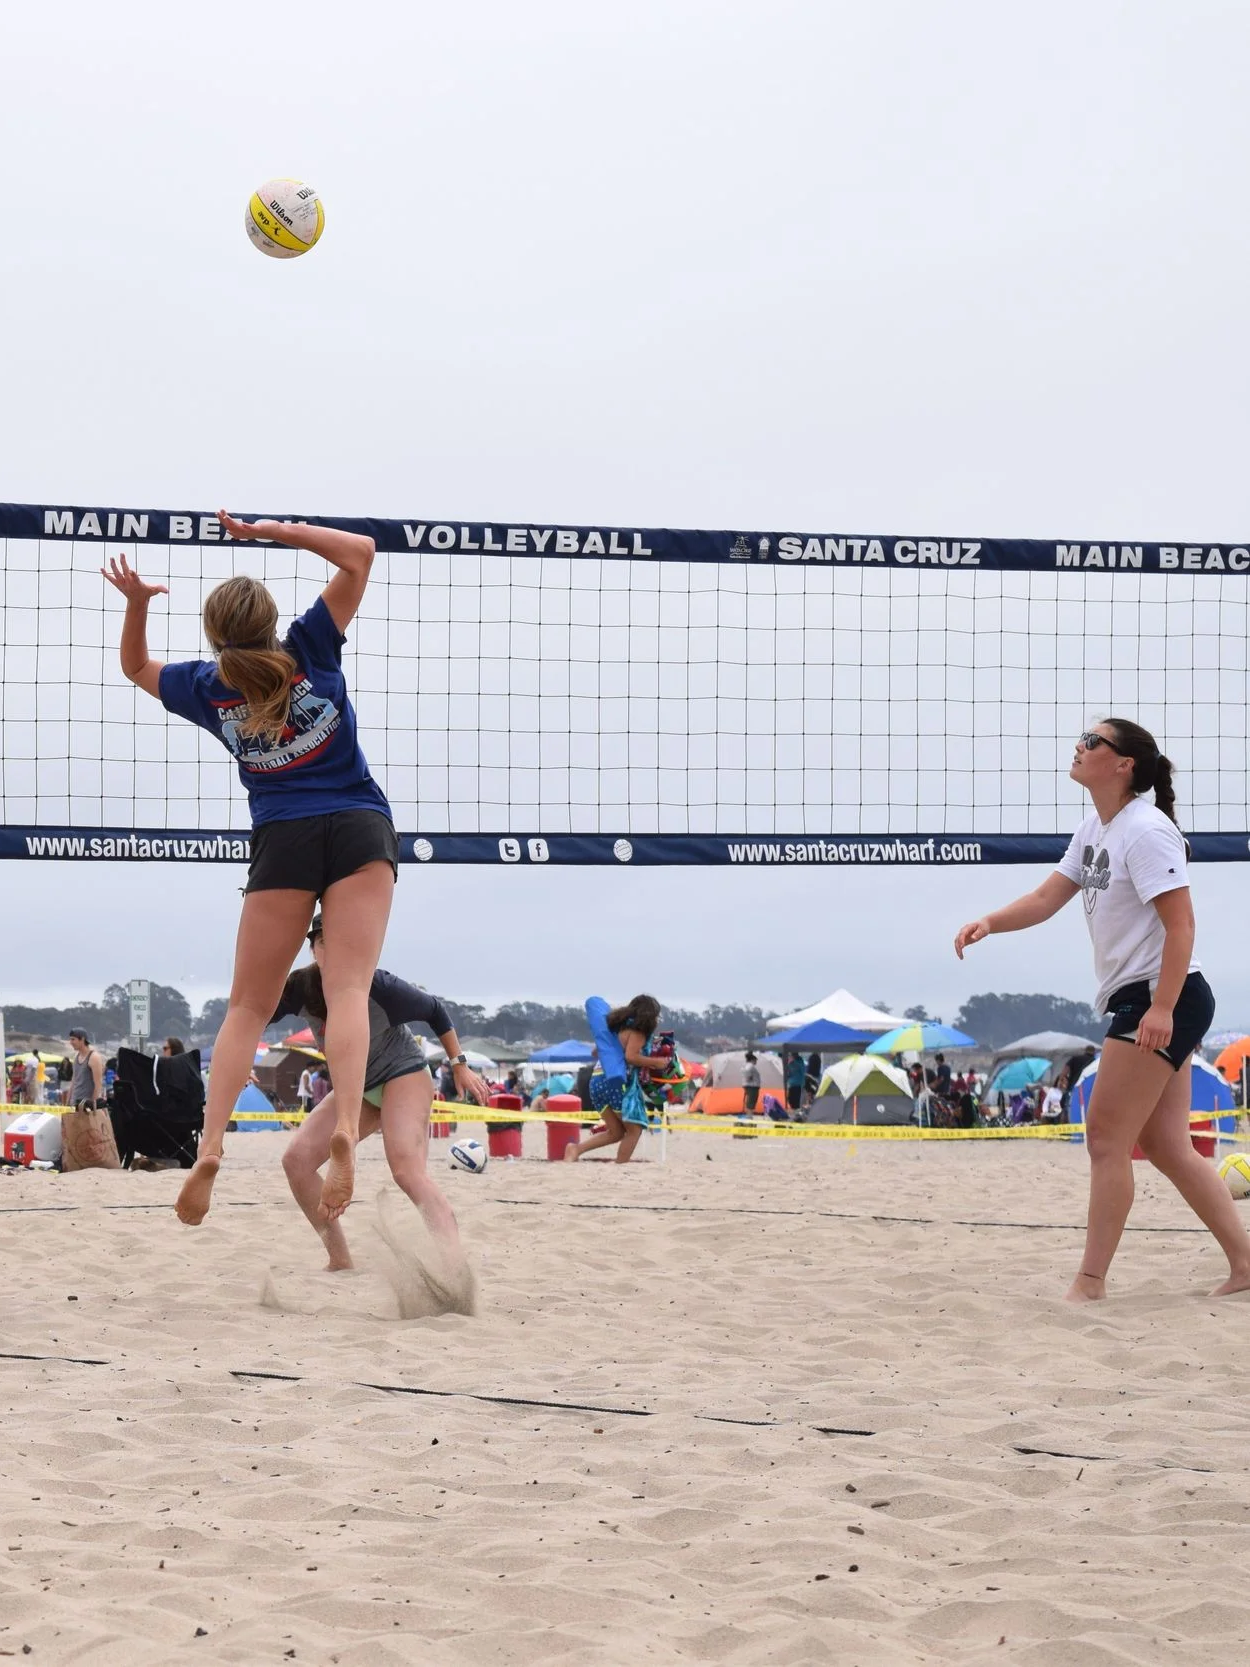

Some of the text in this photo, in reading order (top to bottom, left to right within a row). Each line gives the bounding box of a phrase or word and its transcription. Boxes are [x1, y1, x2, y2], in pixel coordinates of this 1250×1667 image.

[269, 200, 294, 227] Wilson
[44, 510, 149, 538] MAIN
[402, 524, 652, 556] VOLLEYBALL
[777, 536, 886, 562] SANTA
[893, 540, 982, 565] CRUZ
[1055, 544, 1250, 571] MAIN BEAC
[25, 834, 251, 859] www.santacruzwhar
[727, 838, 982, 862] www.santacruzwharf.com
